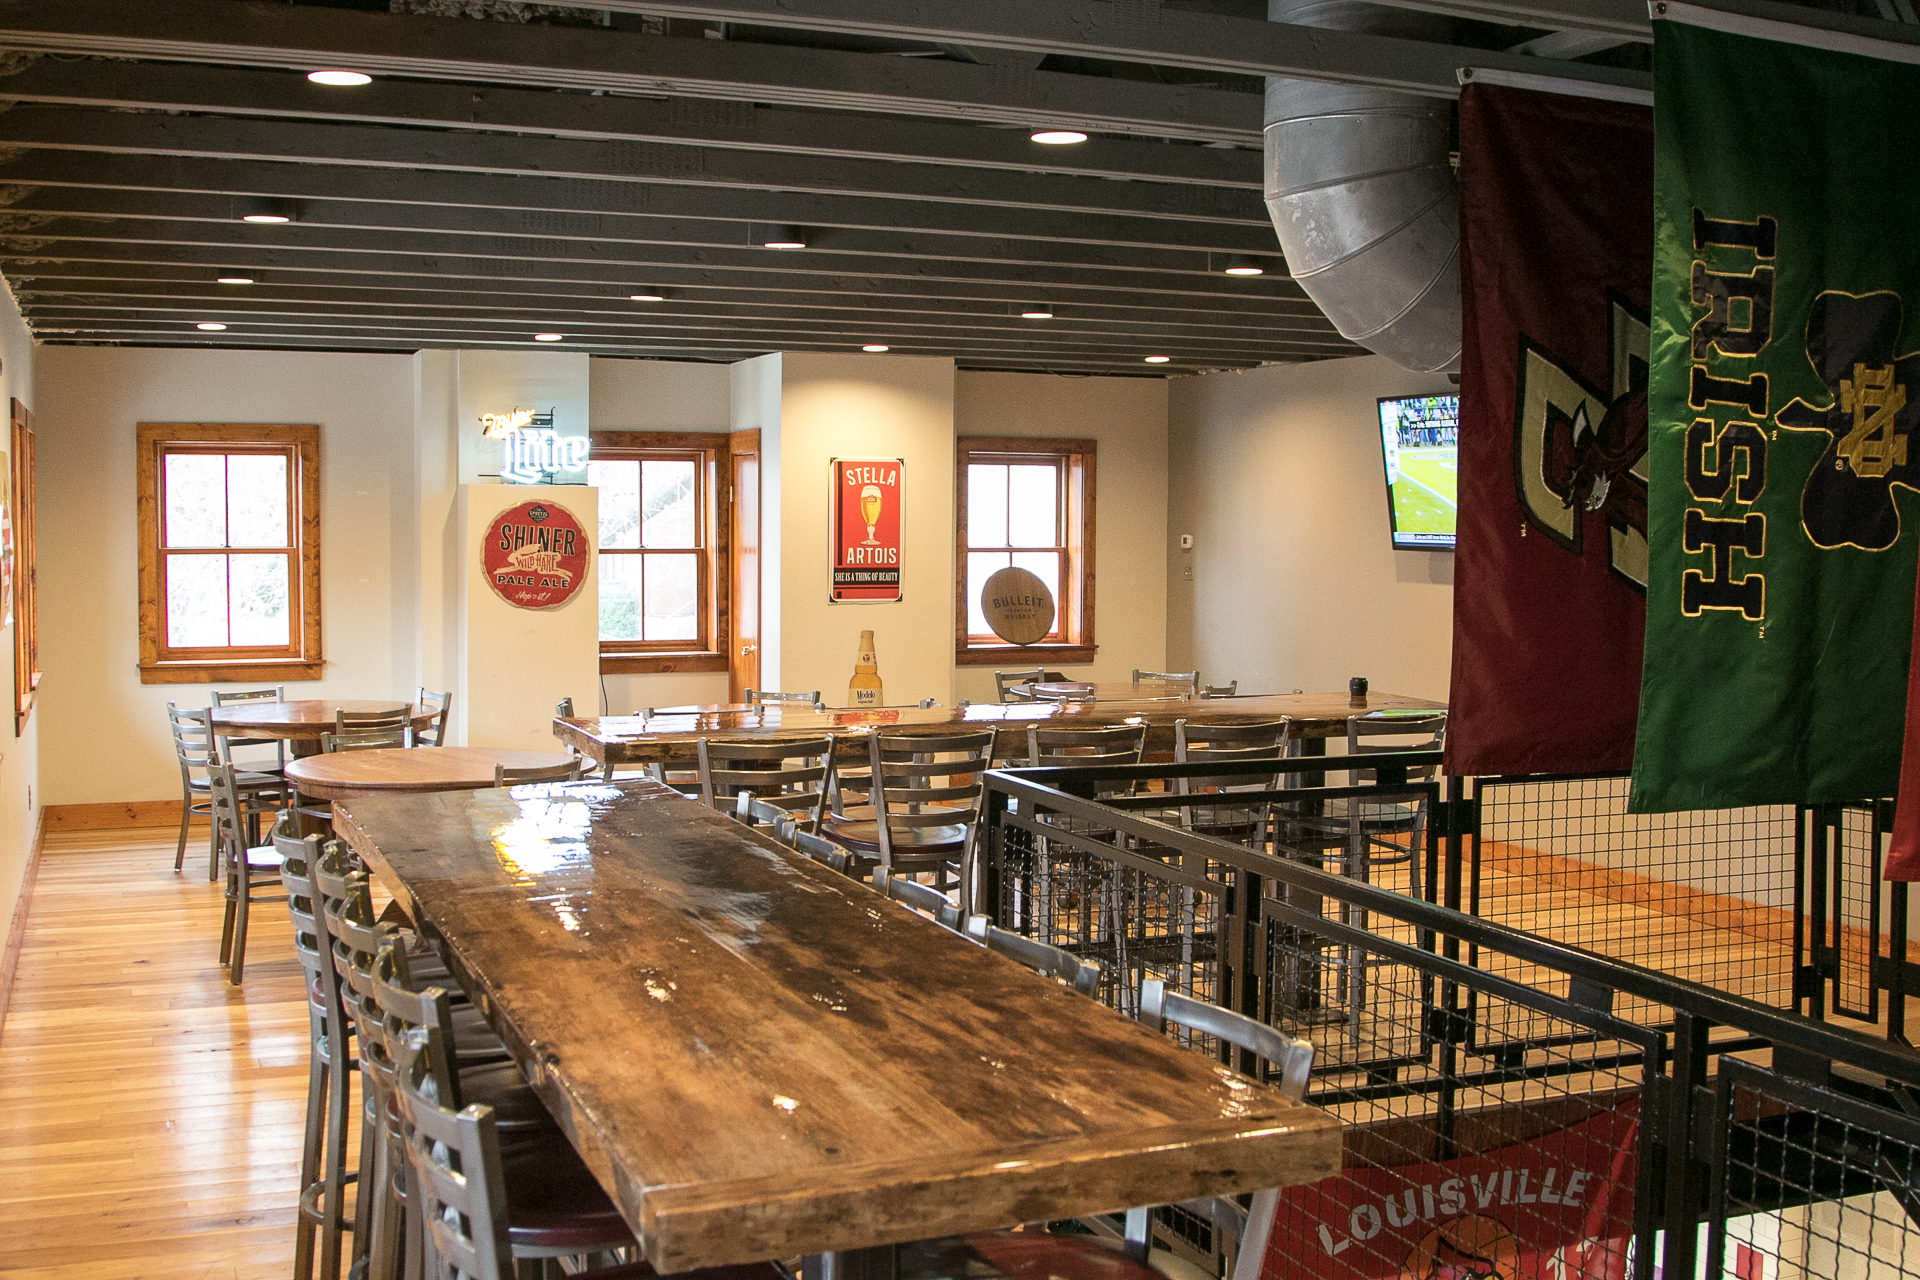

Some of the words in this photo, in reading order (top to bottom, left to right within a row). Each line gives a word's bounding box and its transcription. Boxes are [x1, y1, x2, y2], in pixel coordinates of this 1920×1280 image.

[1680, 205, 1778, 621] IRISH
[500, 429, 591, 484] Lite
[846, 467, 897, 487] STELLA
[499, 523, 577, 557] SHINER
[515, 556, 535, 569] WILD
[536, 554, 559, 573] HARE
[846, 547, 897, 565] ARTOIS
[497, 575, 534, 586] PALE
[540, 577, 570, 588] ALE
[834, 572, 845, 582] SHE
[845, 572, 851, 582] IS
[850, 572, 855, 582] A
[855, 572, 871, 582] THING
[871, 572, 878, 582] OF
[878, 572, 899, 582] BEAUTY
[993, 596, 1043, 609] BULLEIT
[856, 690, 876, 700] Modelo
[1315, 1168, 1593, 1257] LOUISVILLE
